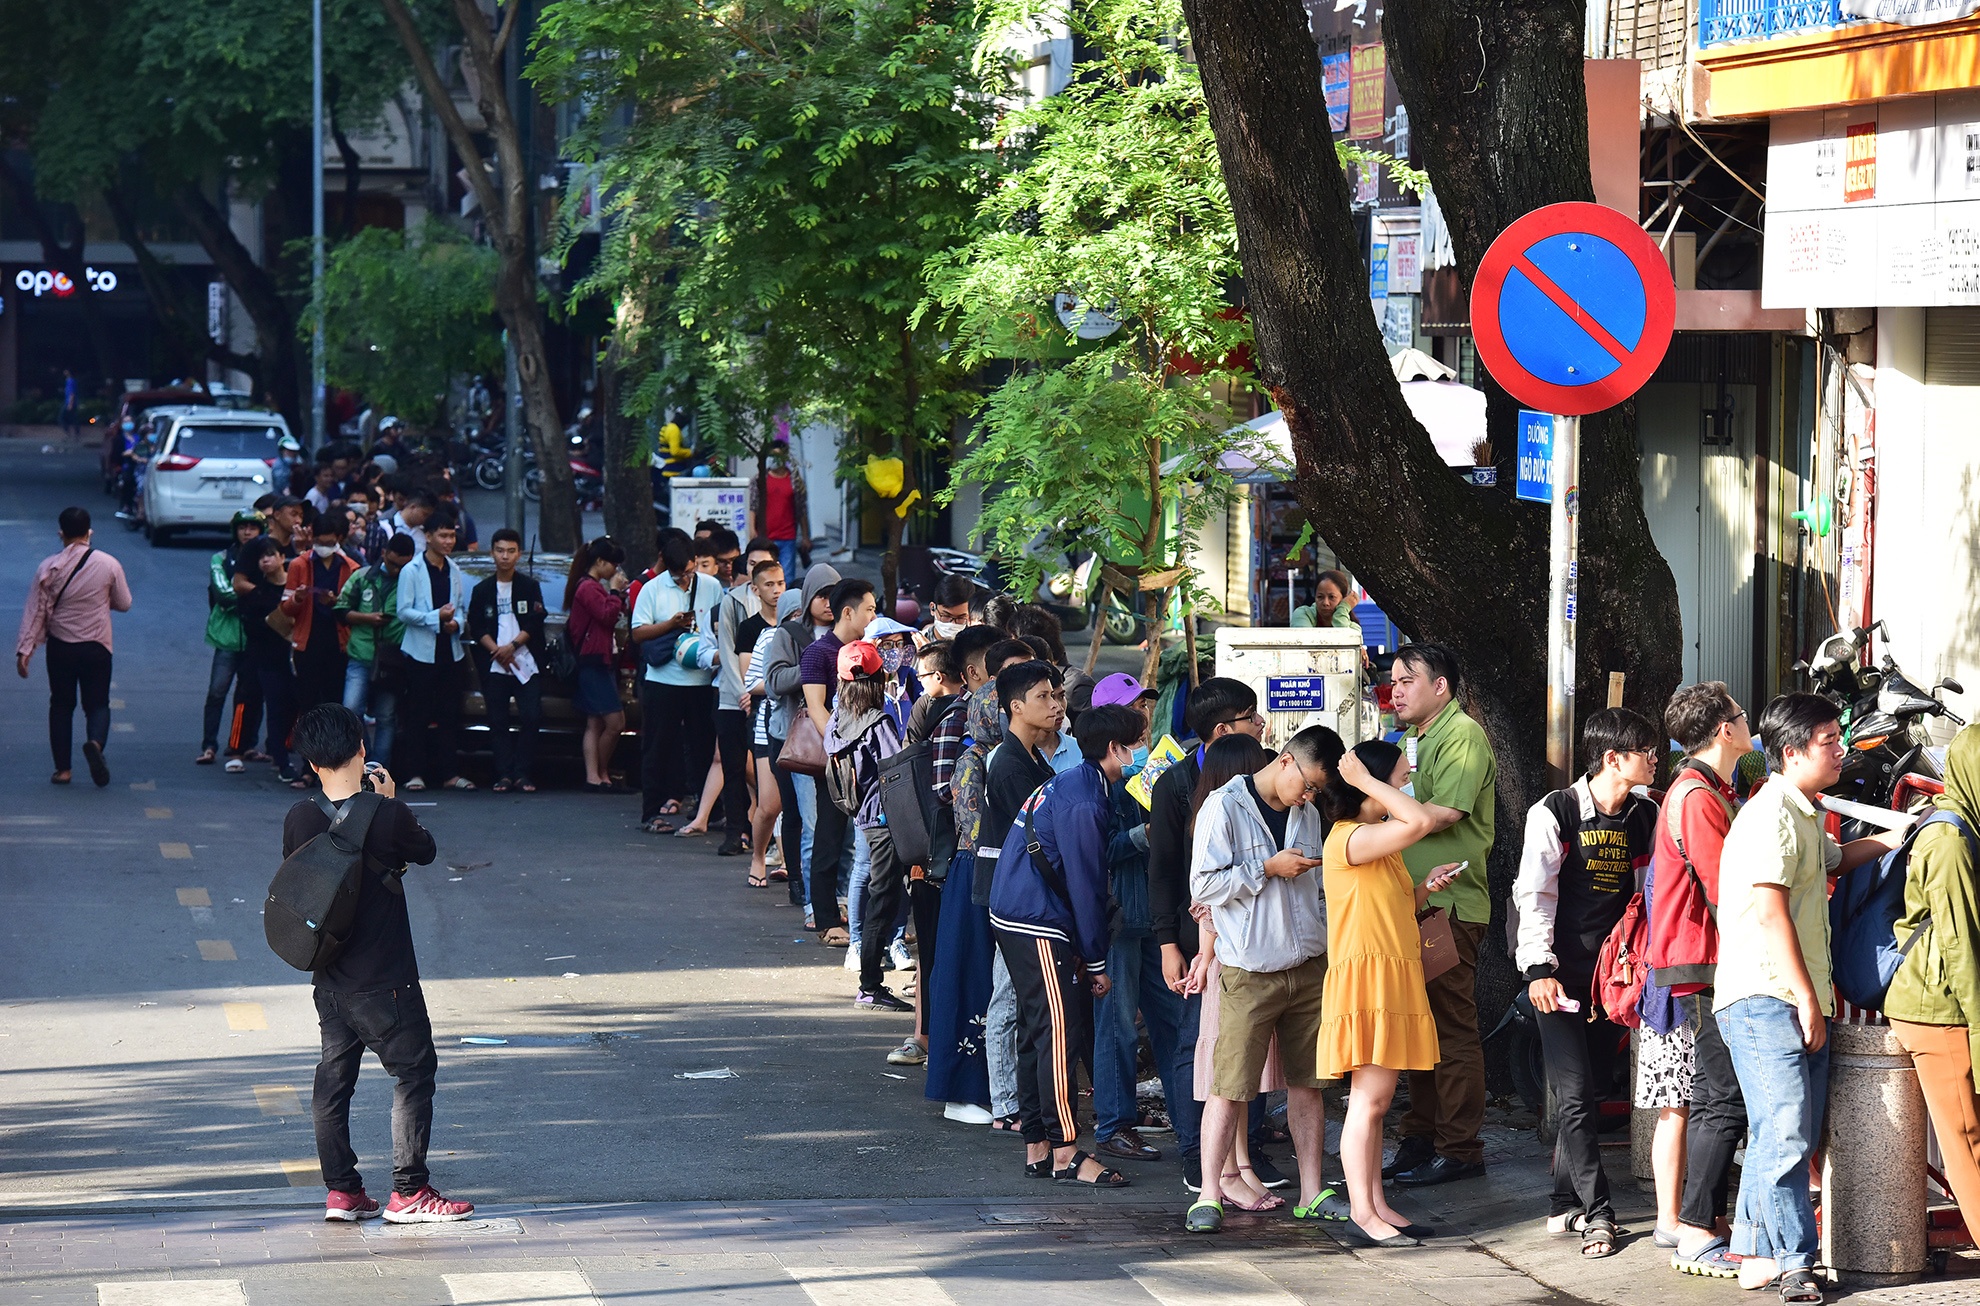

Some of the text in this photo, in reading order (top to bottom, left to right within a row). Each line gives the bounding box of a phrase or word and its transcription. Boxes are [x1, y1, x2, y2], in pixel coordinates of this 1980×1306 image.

[1527, 421, 1548, 444] ĐƯỜNG
[1519, 451, 1532, 482] NGÔ
[1533, 450, 1545, 484] ĐỨC
[1585, 858, 1631, 873] INDUSTRIES
